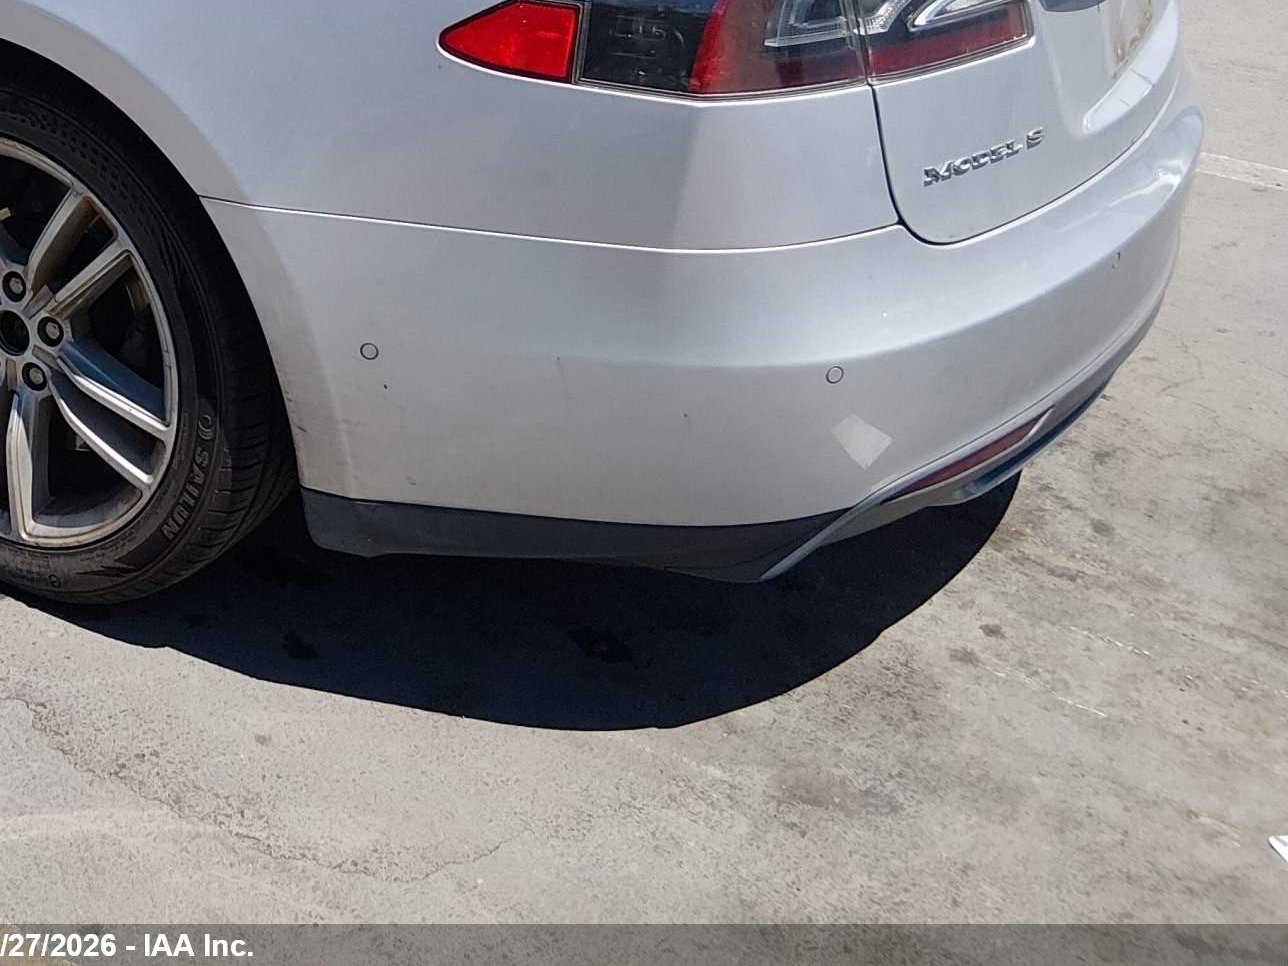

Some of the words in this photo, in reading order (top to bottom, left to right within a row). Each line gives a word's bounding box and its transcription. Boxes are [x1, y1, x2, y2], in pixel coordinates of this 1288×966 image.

[922, 138, 1024, 187] MODEL
[1026, 126, 1044, 150] S
[161, 446, 210, 540] SAILUN
